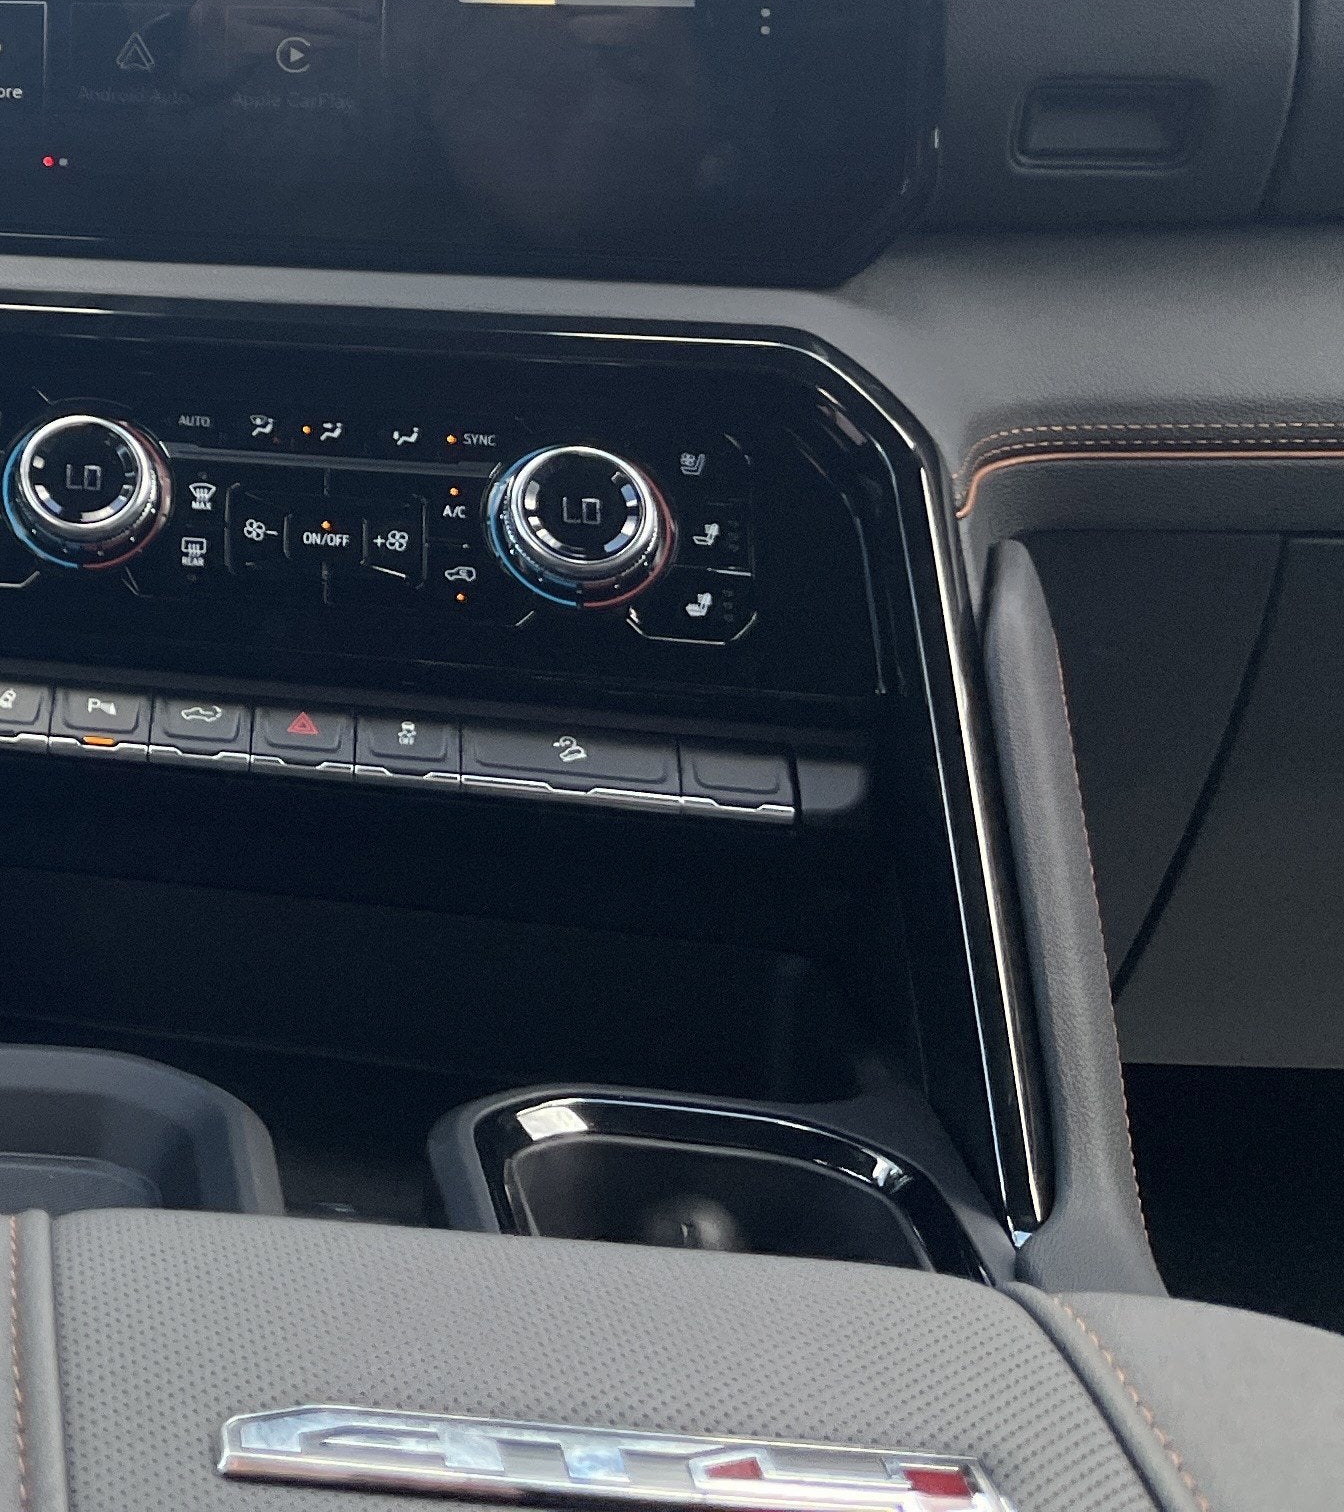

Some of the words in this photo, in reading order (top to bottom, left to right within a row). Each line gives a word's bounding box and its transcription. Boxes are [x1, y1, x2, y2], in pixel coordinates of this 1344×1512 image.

[178, 415, 210, 427] AUTO
[463, 433, 496, 447] SYNC
[191, 500, 212, 510] MAX
[443, 503, 465, 519] A/C
[303, 531, 350, 547] ON/OFF
[181, 556, 205, 567] REAR
